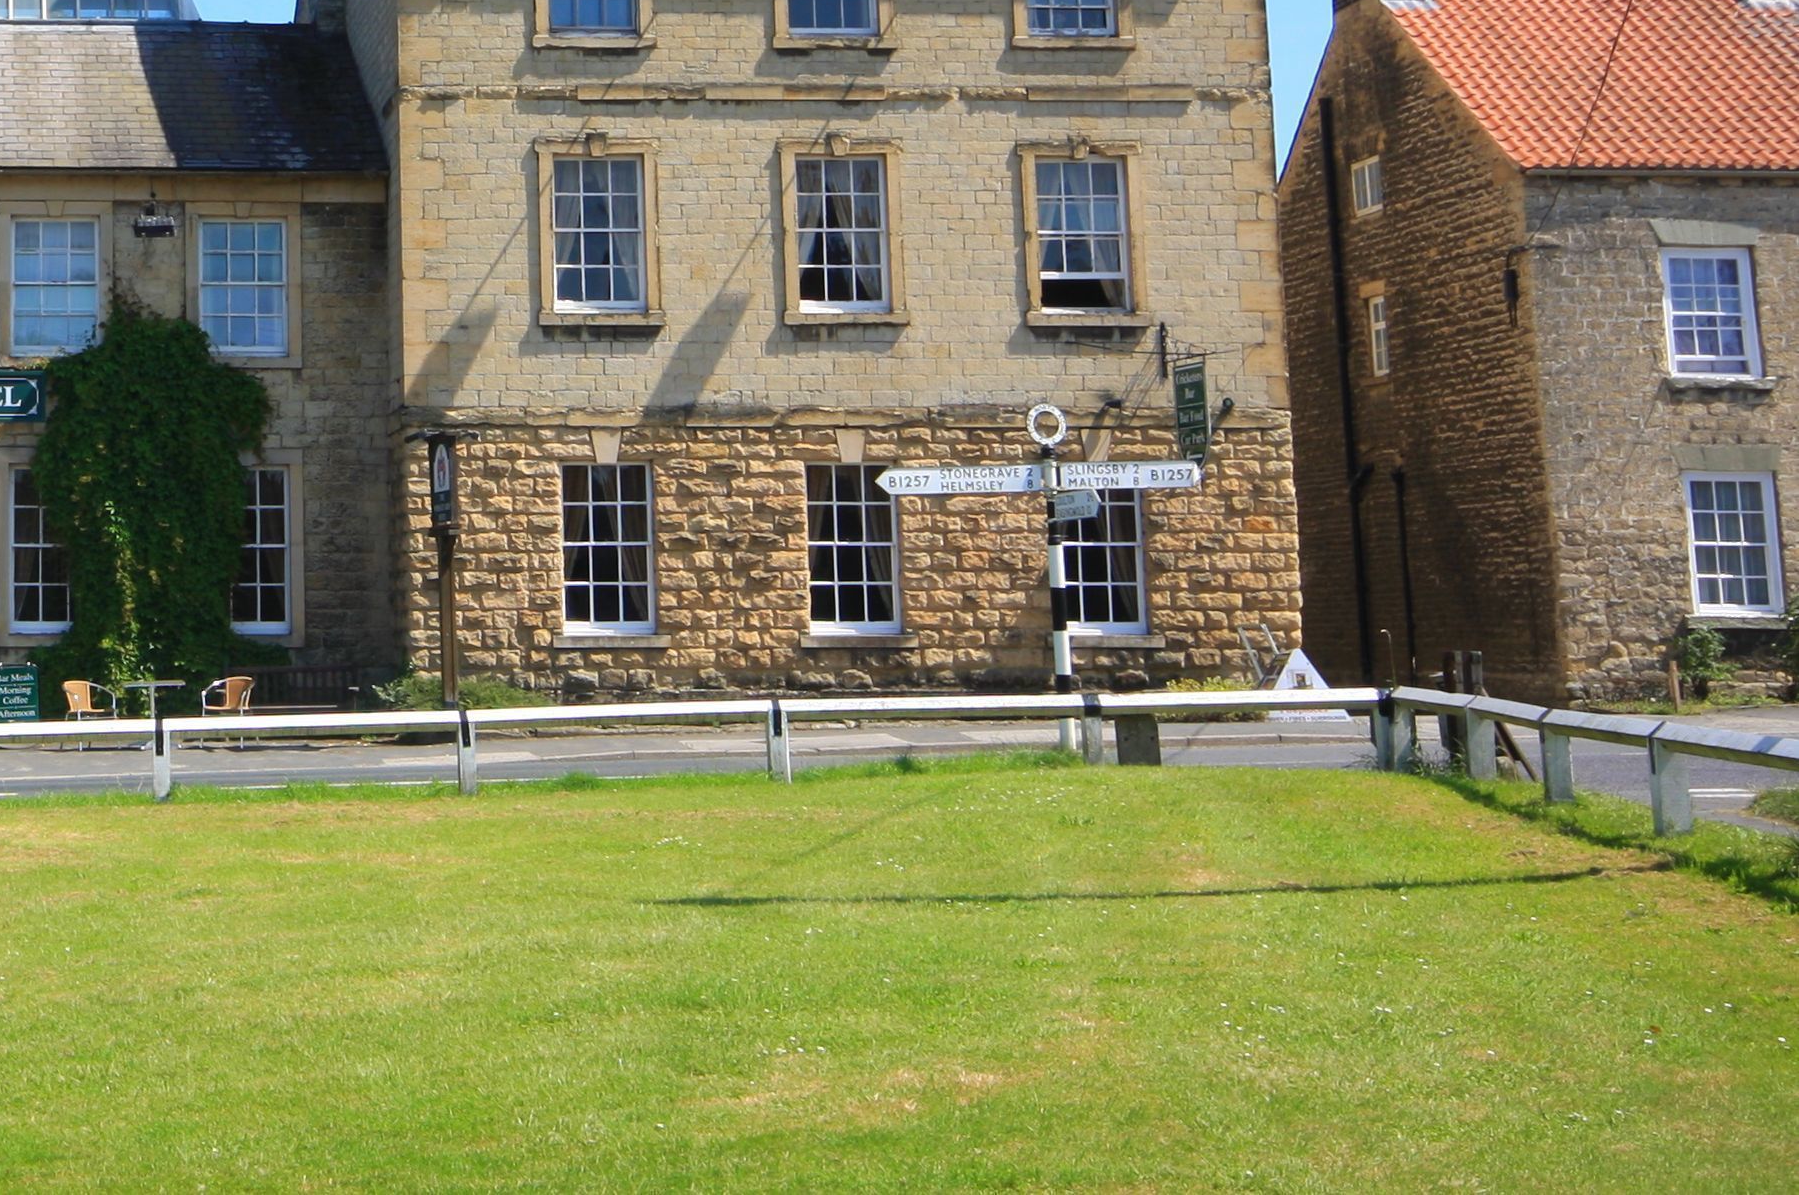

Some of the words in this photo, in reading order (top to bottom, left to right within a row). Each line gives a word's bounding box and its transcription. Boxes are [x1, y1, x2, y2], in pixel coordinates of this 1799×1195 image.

[939, 467, 1020, 479] STONEGRAVE
[1026, 468, 1034, 477] 2
[1067, 464, 1128, 476] SLINGSBY
[1132, 464, 1140, 474] 2
[1151, 469, 1192, 481] B1257
[888, 475, 930, 488] B1257
[940, 480, 1005, 492] HELMSLEY
[1027, 479, 1034, 489] 8
[1068, 477, 1119, 488] MALTON
[1133, 476, 1140, 486] 8
[10, 673, 34, 682] Meals
[0, 687, 32, 695] Morning
[2, 696, 29, 705] Coffee
